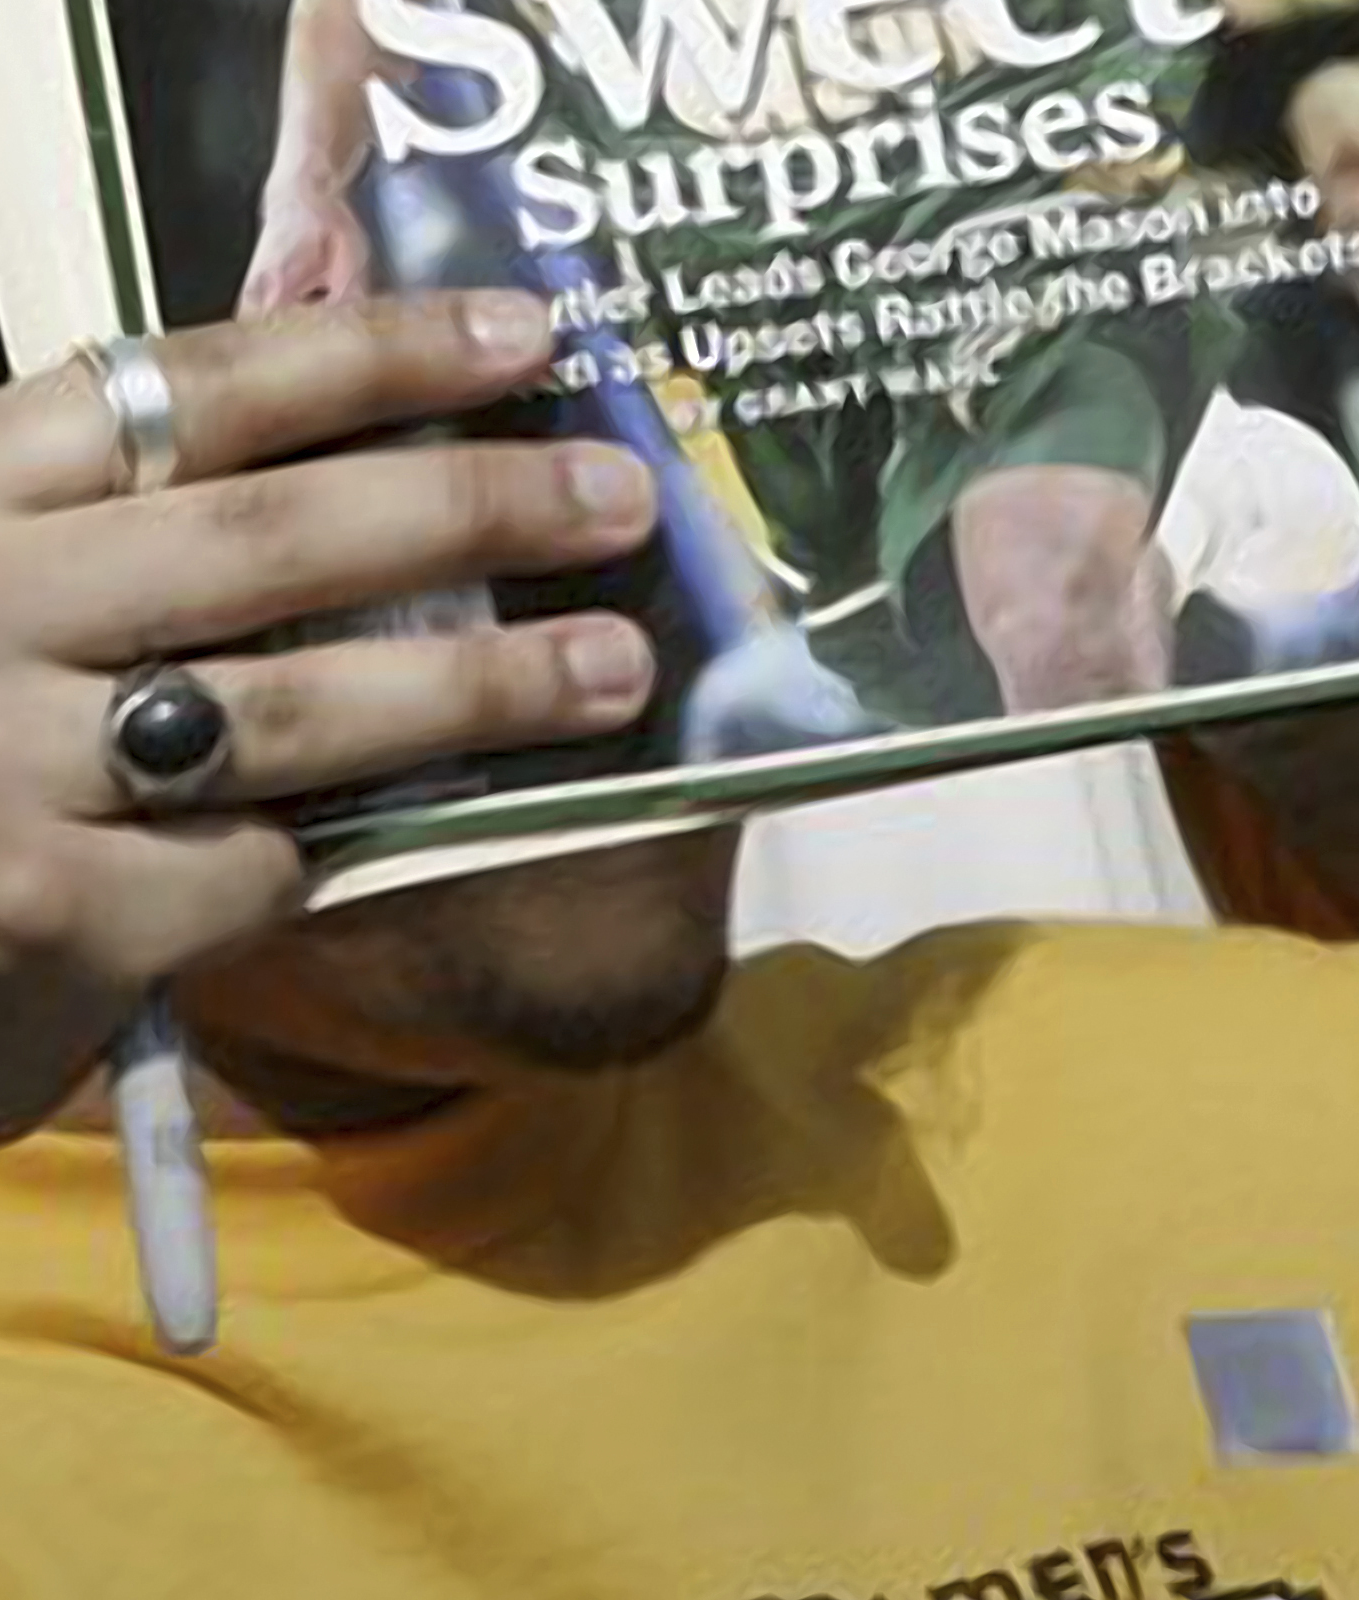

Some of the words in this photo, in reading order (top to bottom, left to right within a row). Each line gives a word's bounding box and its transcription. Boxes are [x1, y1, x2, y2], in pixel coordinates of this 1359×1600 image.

[510, 78, 1164, 250] Surprises
[832, 222, 1022, 292] George
[1026, 193, 1210, 260] Mason
